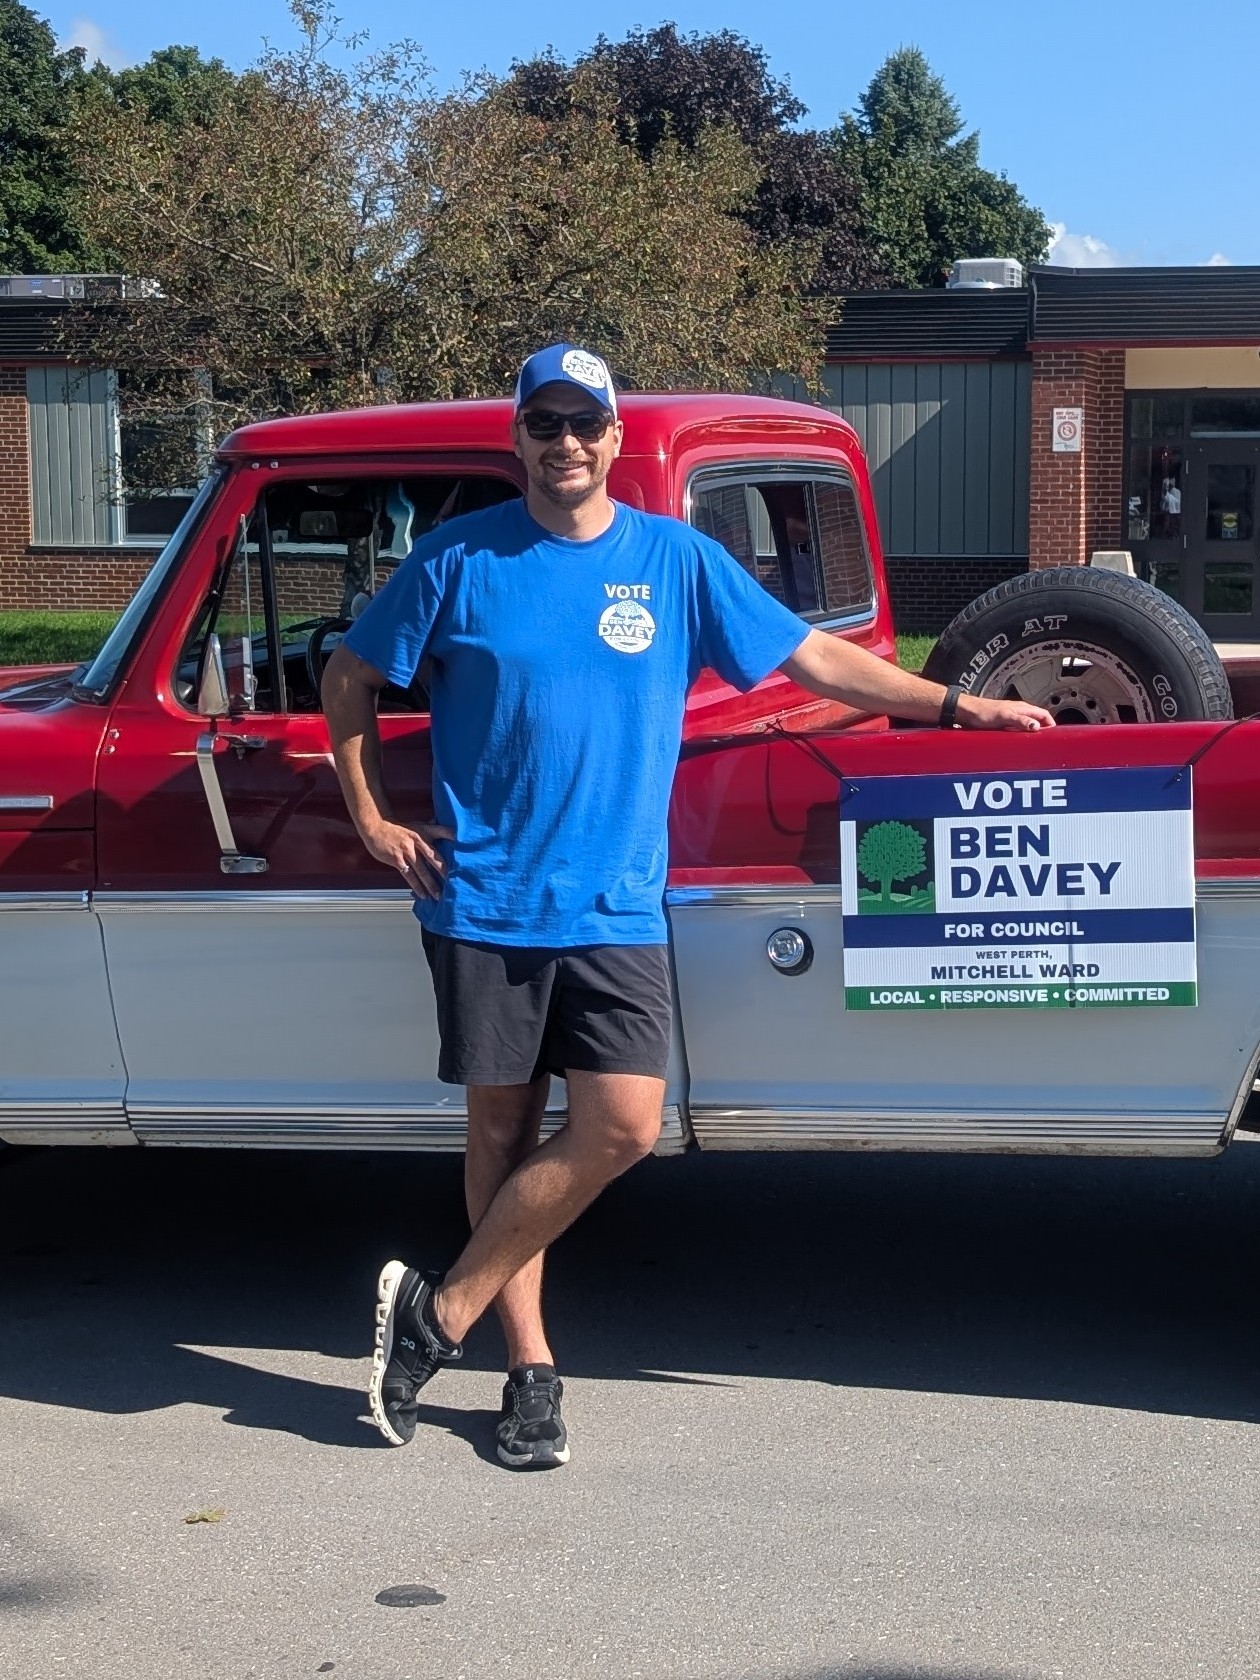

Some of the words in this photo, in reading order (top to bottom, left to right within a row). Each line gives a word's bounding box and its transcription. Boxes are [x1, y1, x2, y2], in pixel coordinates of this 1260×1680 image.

[604, 583, 651, 600] VOTE
[599, 624, 656, 640] DAVEY
[959, 633, 1010, 694] LER
[1021, 615, 1068, 637] AT
[1152, 674, 1178, 722] GO
[953, 778, 1068, 810] VOTE
[950, 824, 1050, 859] BEN
[951, 861, 1122, 898] DAVEY
[944, 923, 985, 938] FOR
[990, 921, 1085, 937] COUNCIL
[975, 951, 1007, 959] WEST
[1011, 950, 1053, 960] PERTH,
[931, 965, 1033, 980] MITCHELL
[1039, 963, 1100, 978] WARD
[870, 990, 926, 1005] LOCAL
[940, 989, 1049, 1004] RESPONSIVE
[1064, 987, 1170, 1003] COMMITTED
